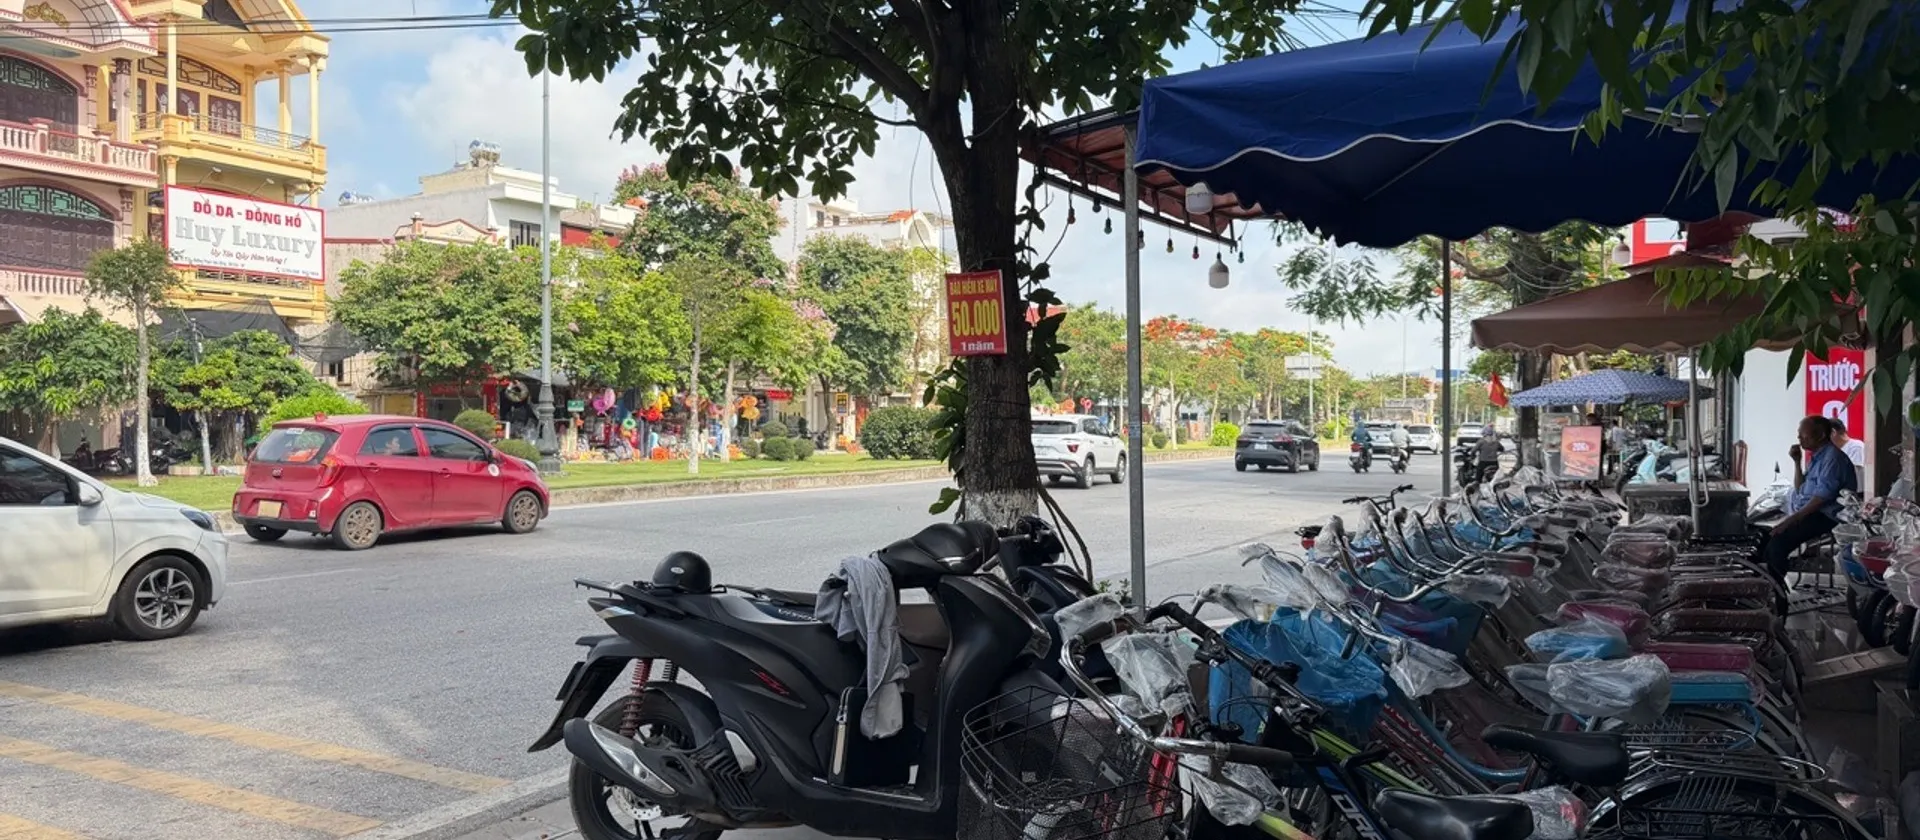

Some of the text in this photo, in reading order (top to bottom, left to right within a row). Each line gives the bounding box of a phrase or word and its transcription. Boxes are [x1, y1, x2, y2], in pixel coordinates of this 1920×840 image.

[215, 206, 234, 219] DA
[175, 216, 318, 259] Huy Luxury
[951, 299, 1000, 337] 50.000
[961, 340, 995, 351] 1 năm
[1808, 357, 1860, 391] TRƯỚC
